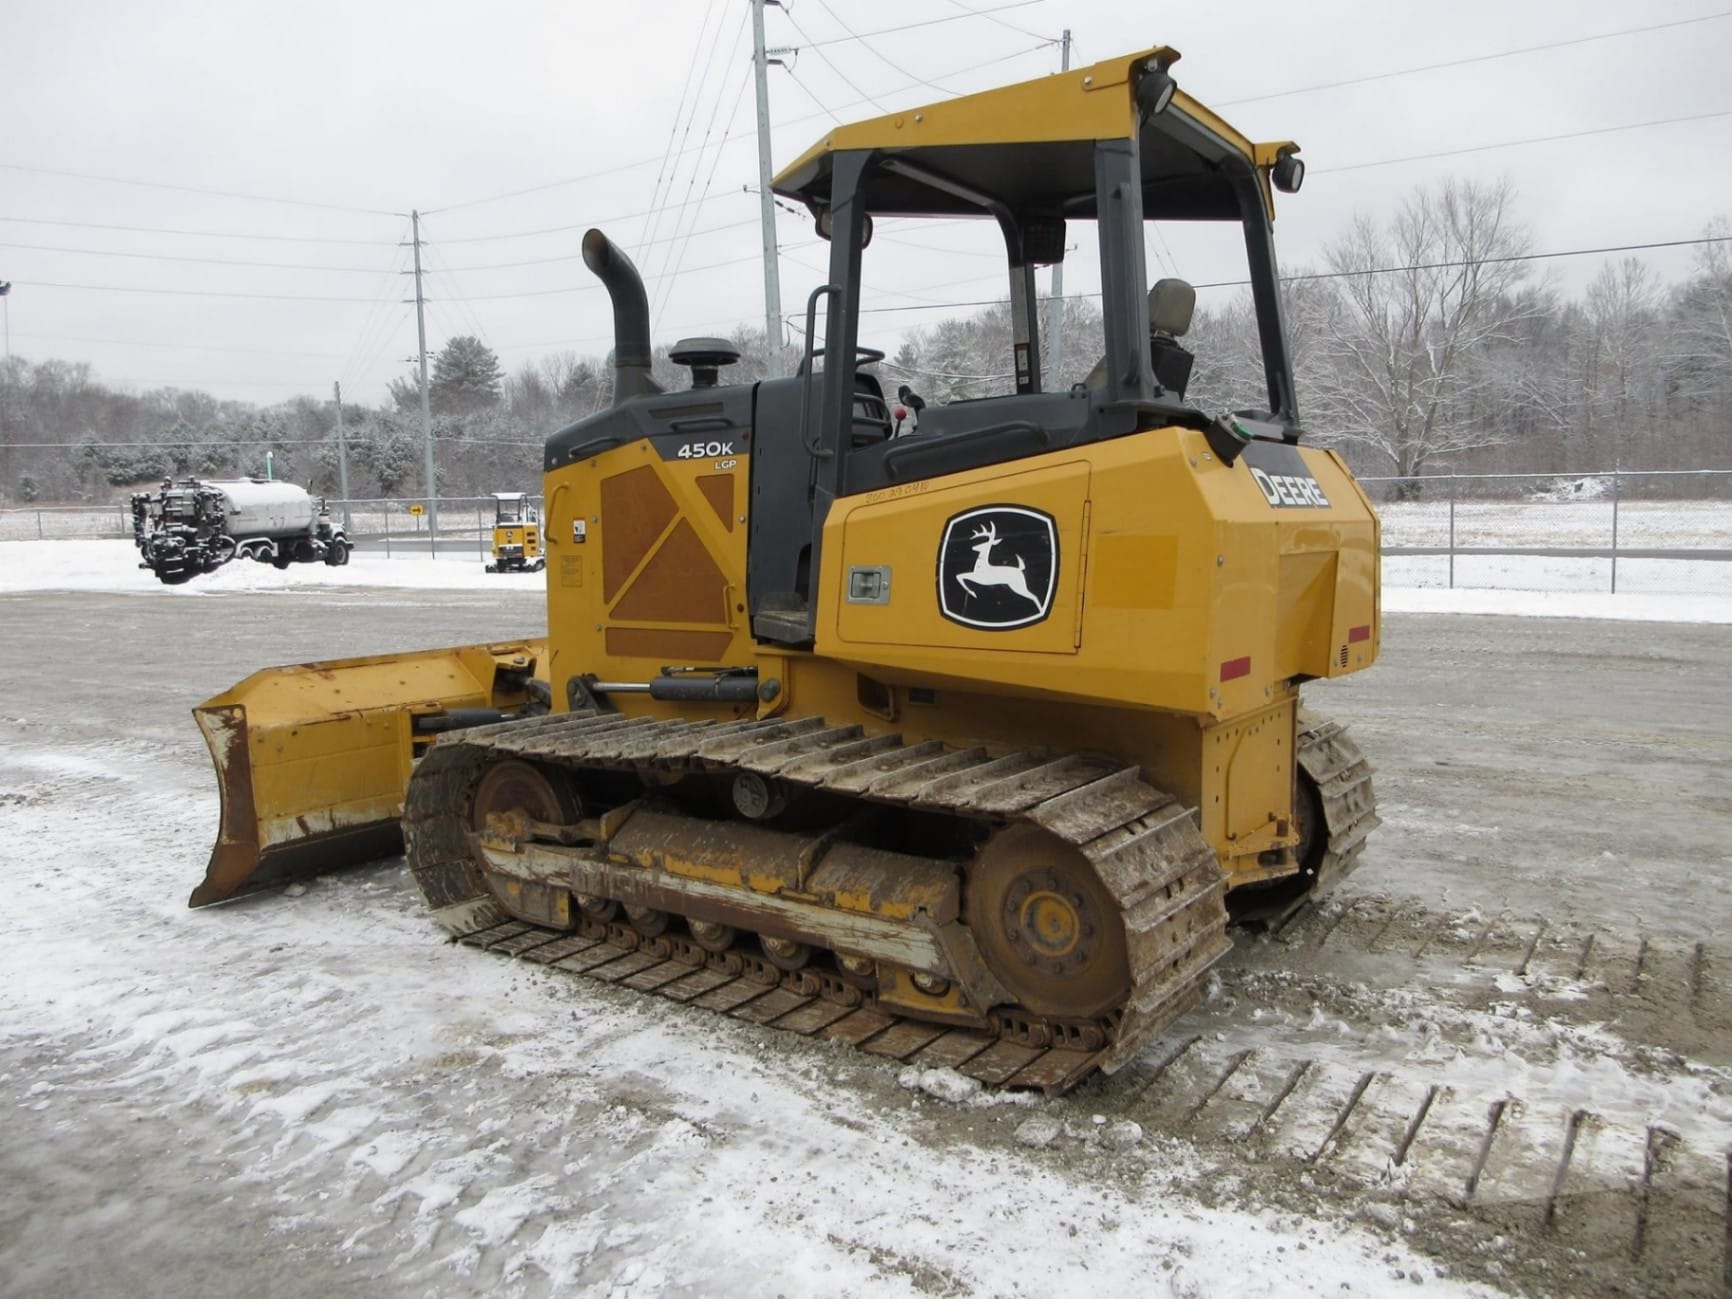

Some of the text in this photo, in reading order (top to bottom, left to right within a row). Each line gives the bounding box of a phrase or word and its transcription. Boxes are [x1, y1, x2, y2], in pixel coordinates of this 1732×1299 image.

[677, 441, 734, 459] 450K
[714, 459, 737, 470] LGP
[1249, 467, 1329, 506] DEERE
